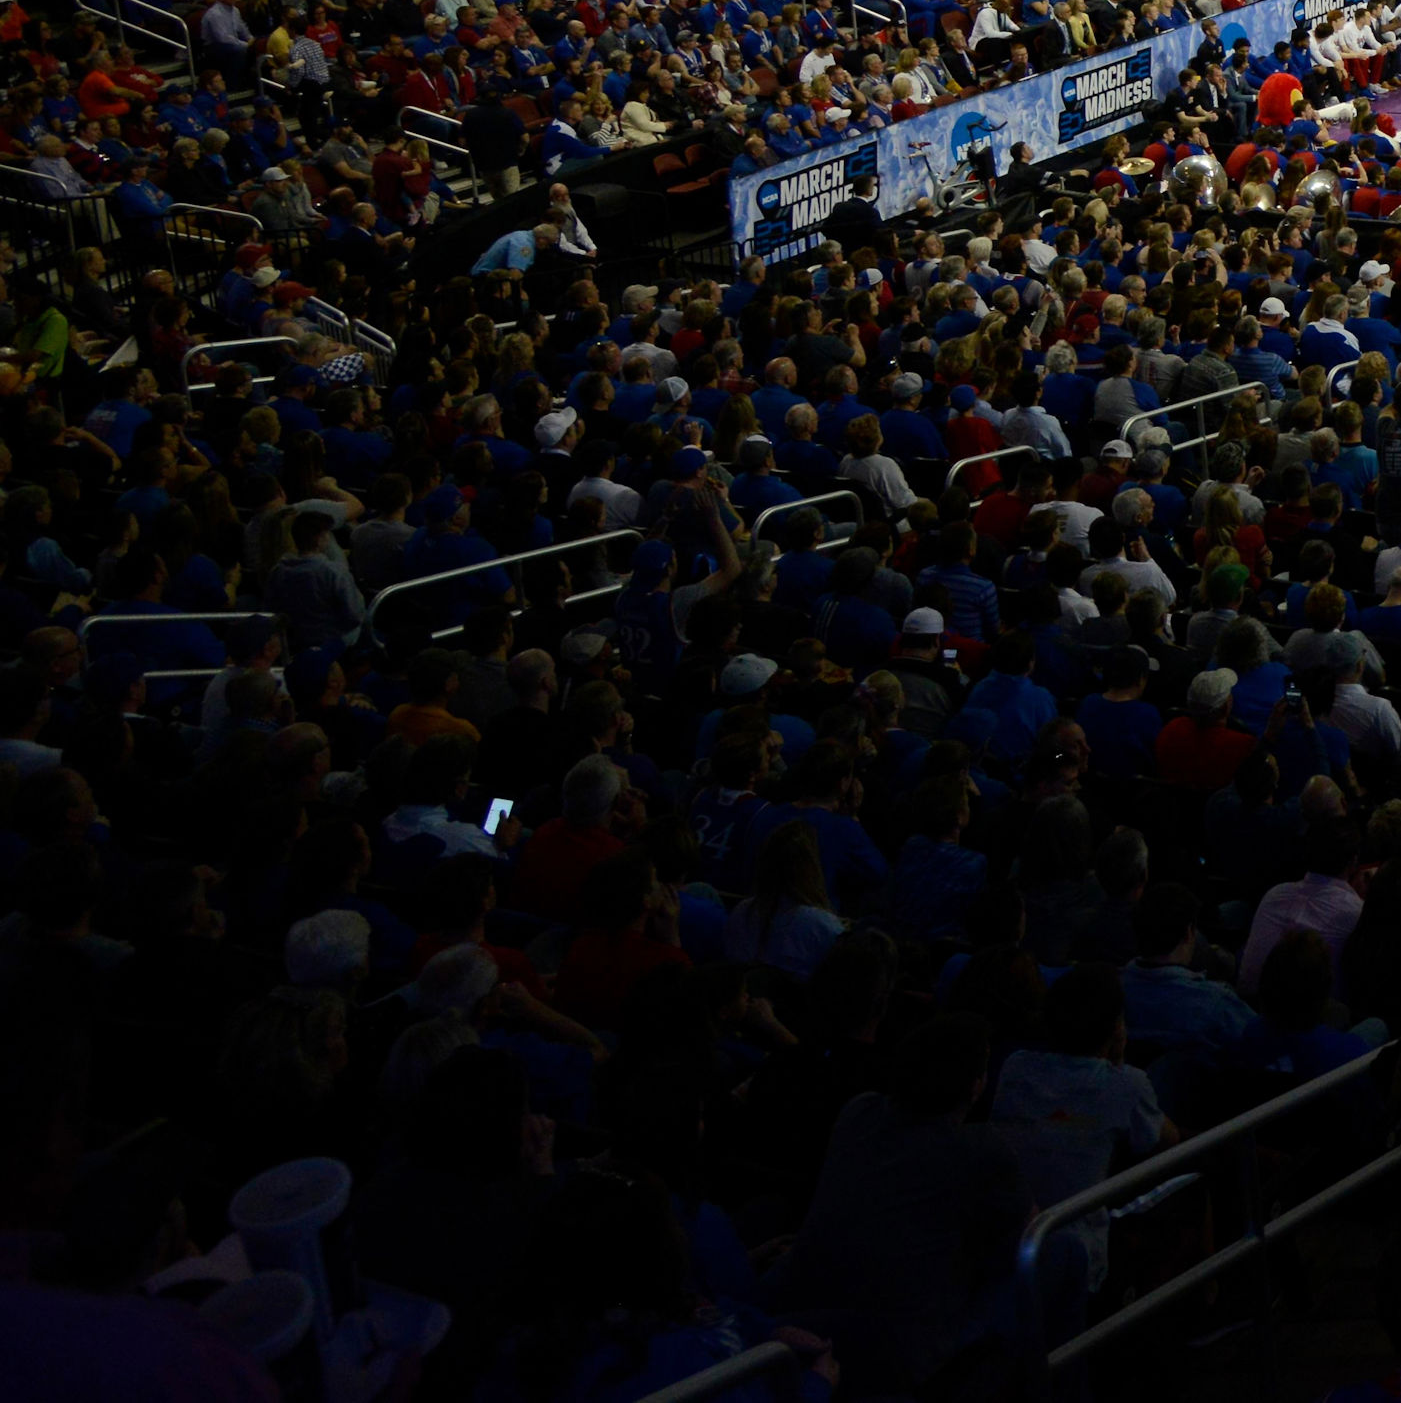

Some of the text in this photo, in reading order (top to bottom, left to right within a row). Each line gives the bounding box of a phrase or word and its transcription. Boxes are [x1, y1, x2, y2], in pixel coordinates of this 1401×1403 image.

[1076, 62, 1127, 101] MARCH
[1085, 77, 1152, 122] MADNESS
[780, 159, 845, 207] MARCH
